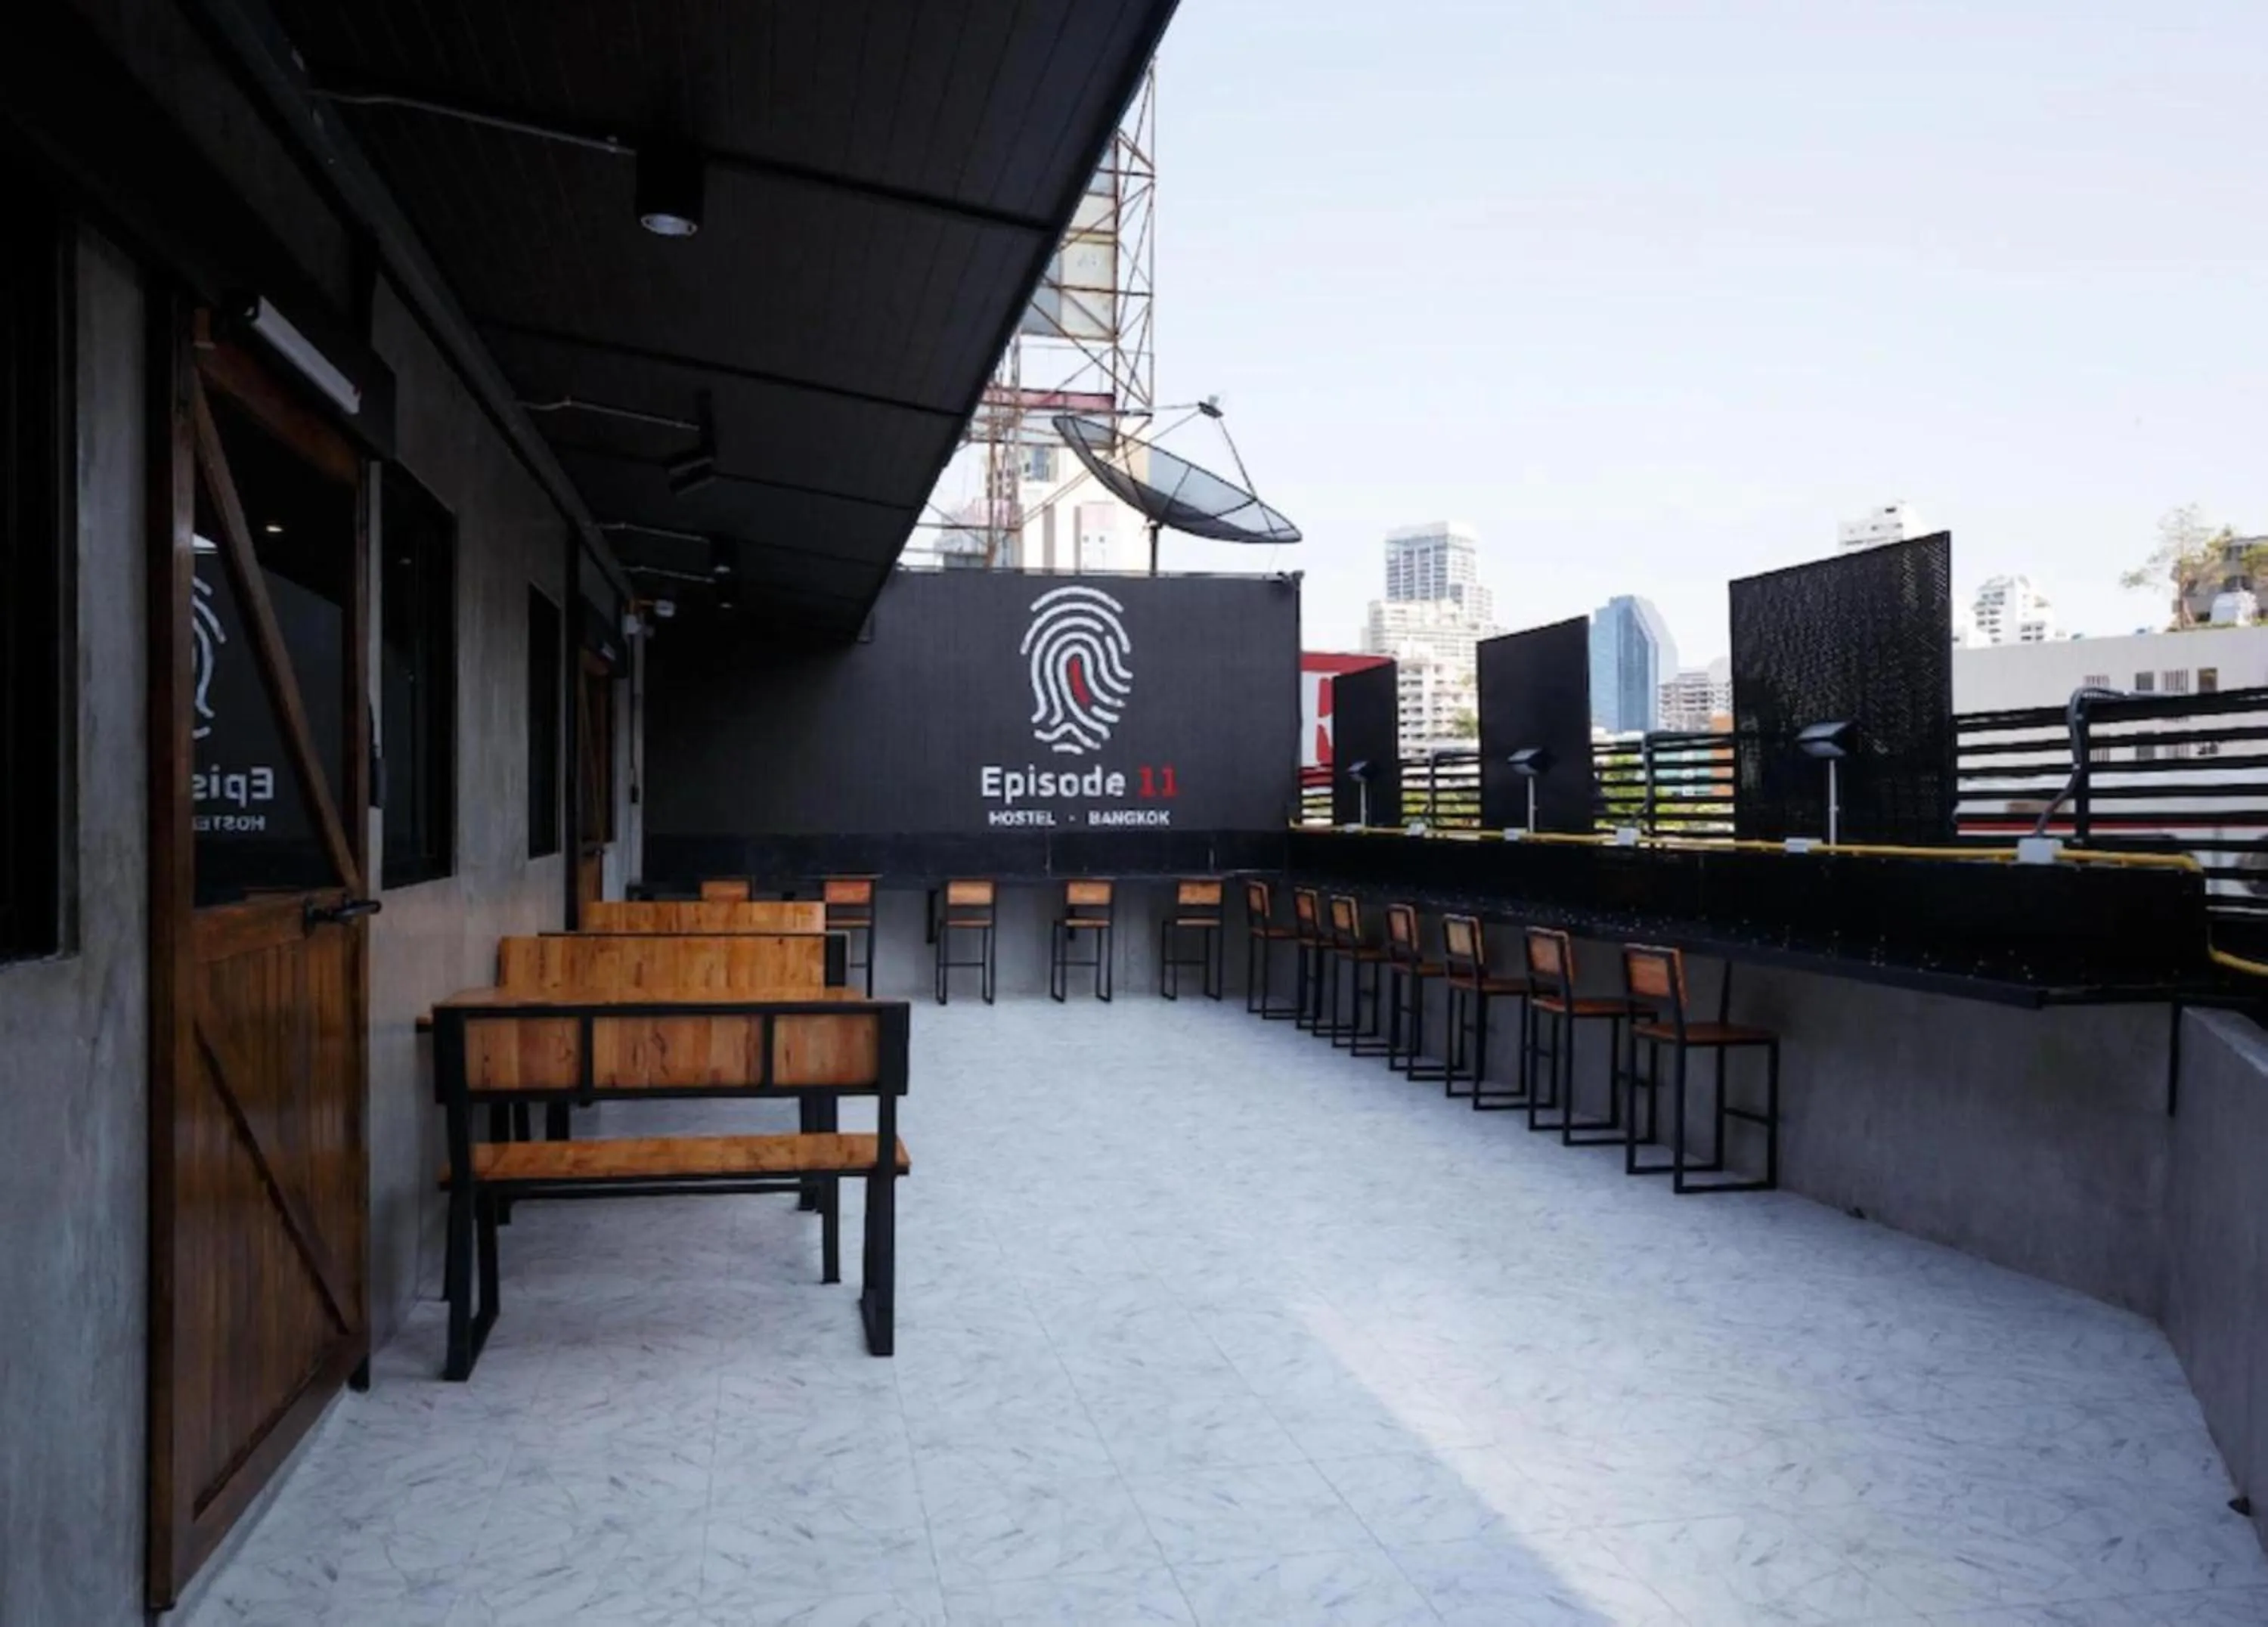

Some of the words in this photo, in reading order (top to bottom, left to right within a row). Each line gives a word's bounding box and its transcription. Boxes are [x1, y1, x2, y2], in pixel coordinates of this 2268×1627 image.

[981, 764, 1126, 804] Episode
[1139, 765, 1179, 798] 11
[988, 810, 1056, 826] HOSTEL
[1088, 810, 1170, 826] BANGKOK
